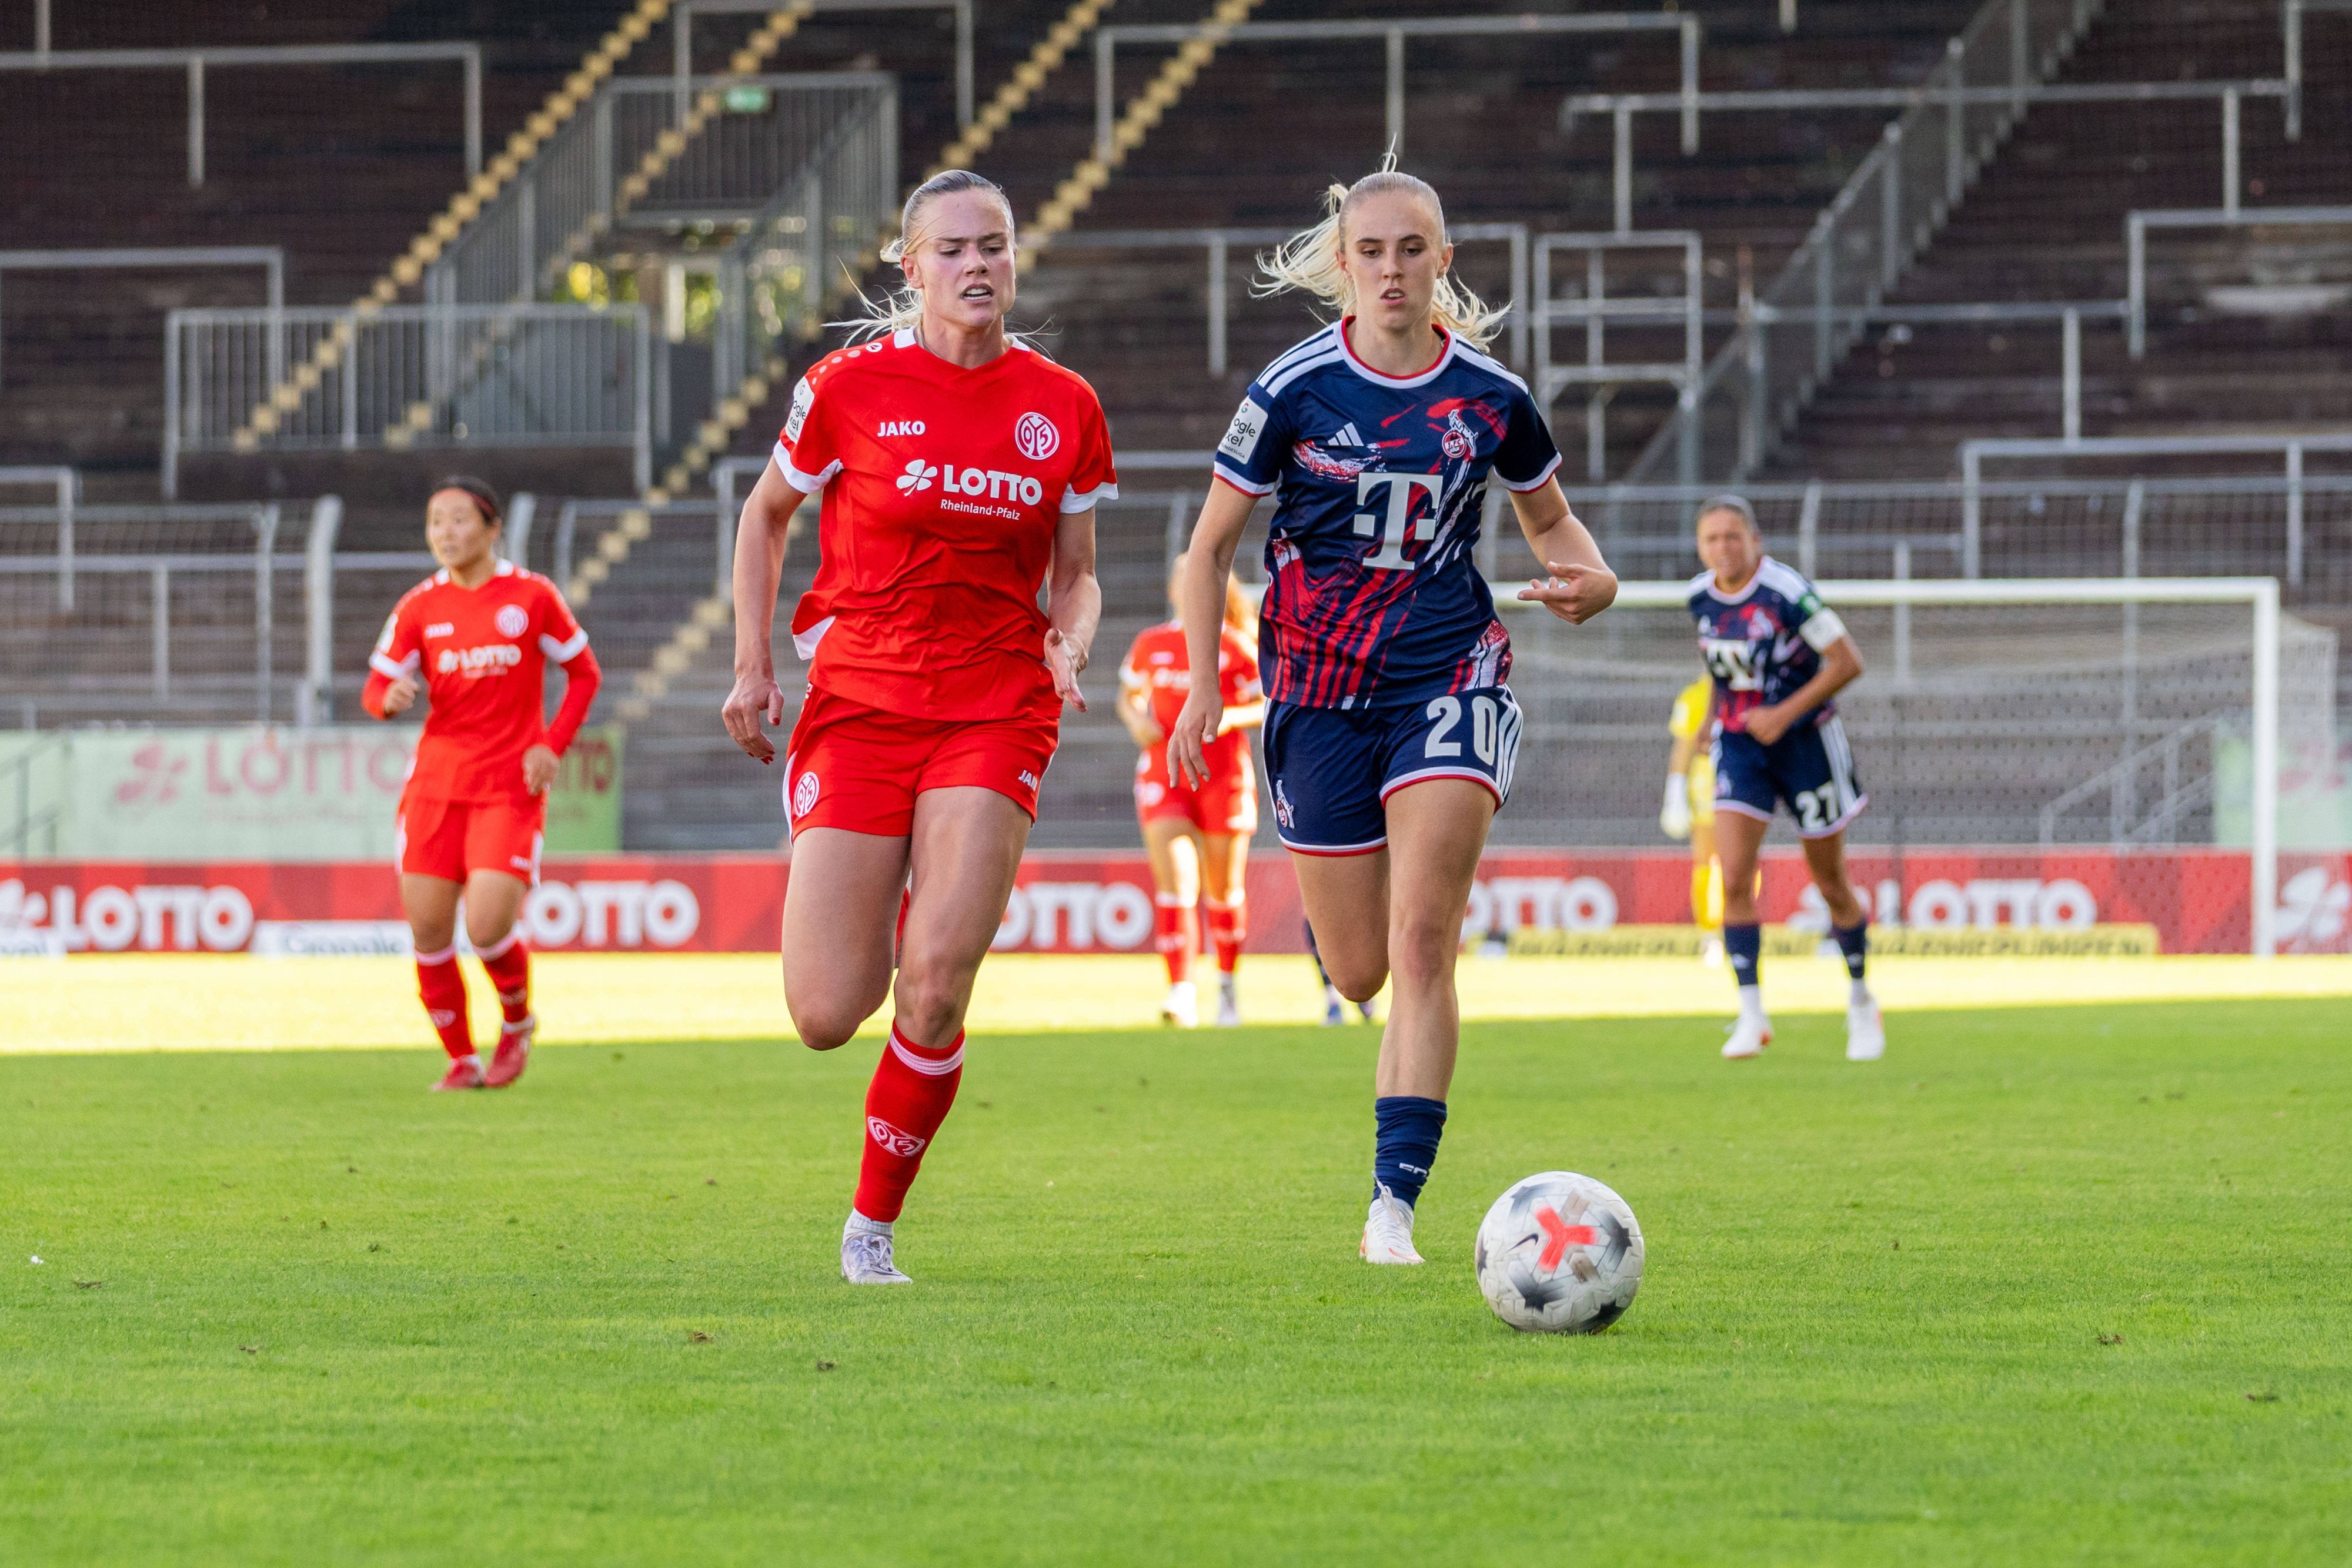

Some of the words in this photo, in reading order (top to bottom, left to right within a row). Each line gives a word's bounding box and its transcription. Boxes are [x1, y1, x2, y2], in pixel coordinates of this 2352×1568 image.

[793, 400, 806, 421] ogle
[877, 420, 926, 437] JAKO
[1225, 432, 1244, 447] xel
[1234, 418, 1256, 437] ogle
[943, 464, 1043, 506] LOTTO
[940, 499, 1021, 521] Rheinland-Pfalz
[459, 644, 522, 670] LOTTO
[1424, 696, 1497, 766] 20
[1018, 770, 1037, 791] JAK
[1796, 780, 1840, 831] 27
[51, 885, 254, 951] LOTTO
[515, 880, 700, 948] OTTO
